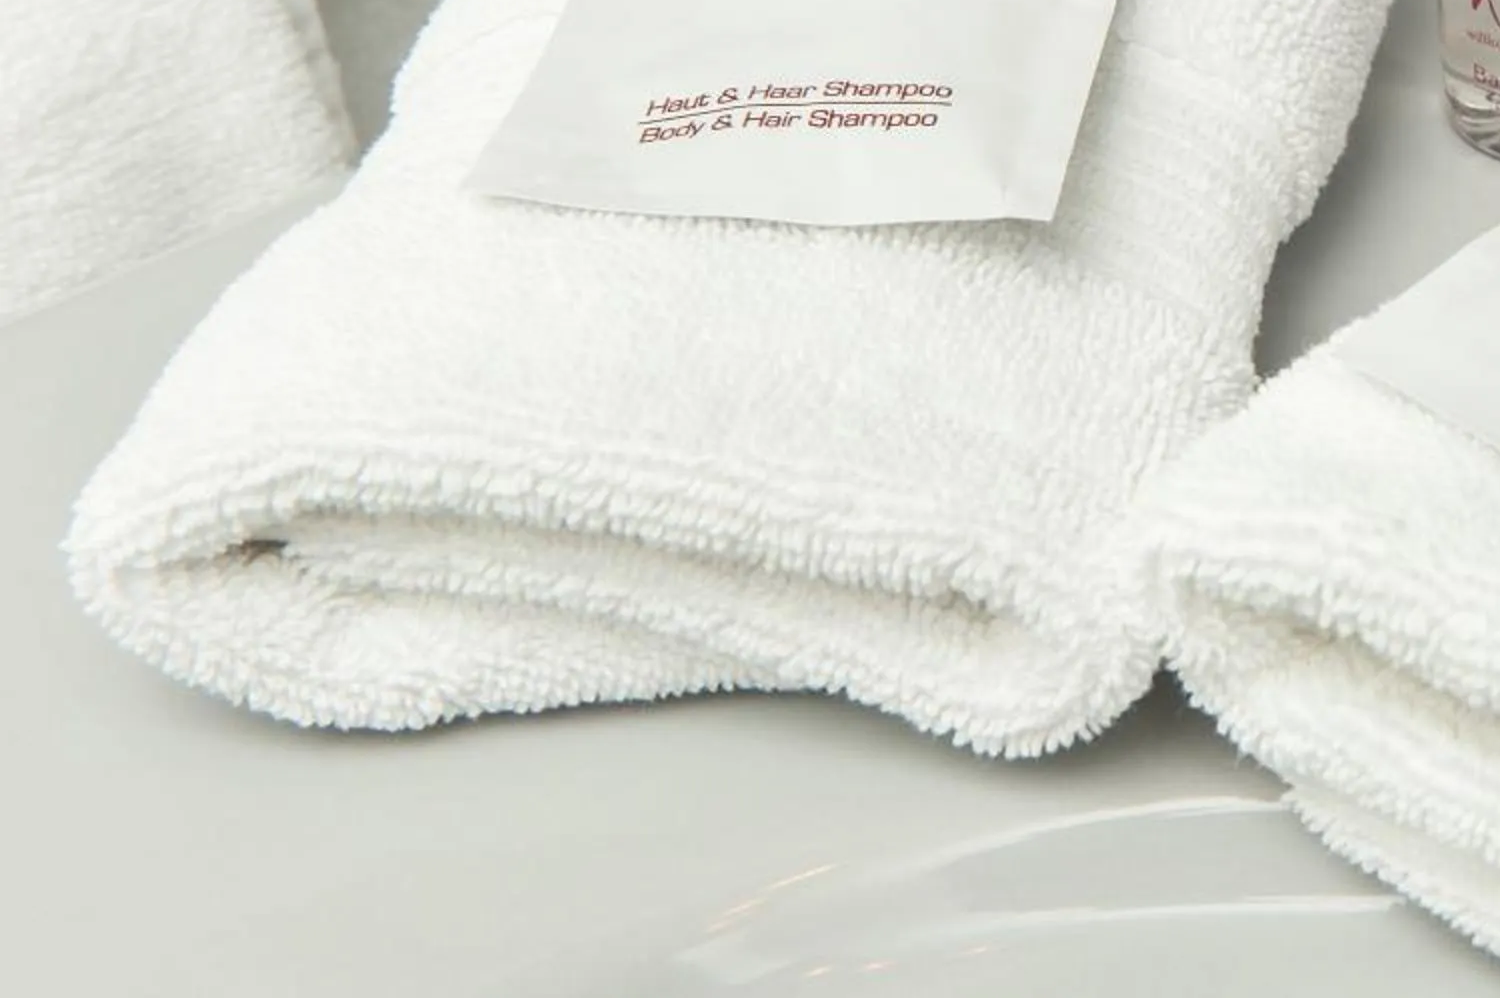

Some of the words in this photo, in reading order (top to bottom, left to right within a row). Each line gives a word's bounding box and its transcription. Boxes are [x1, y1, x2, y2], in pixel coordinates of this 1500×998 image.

[646, 94, 711, 117] Haut
[717, 87, 739, 103] &
[748, 85, 817, 100] Haar
[822, 81, 952, 100] Shampoo
[639, 120, 704, 145] Body
[711, 114, 733, 131] &
[742, 111, 802, 128] Hair
[808, 109, 938, 130] Shampoo
